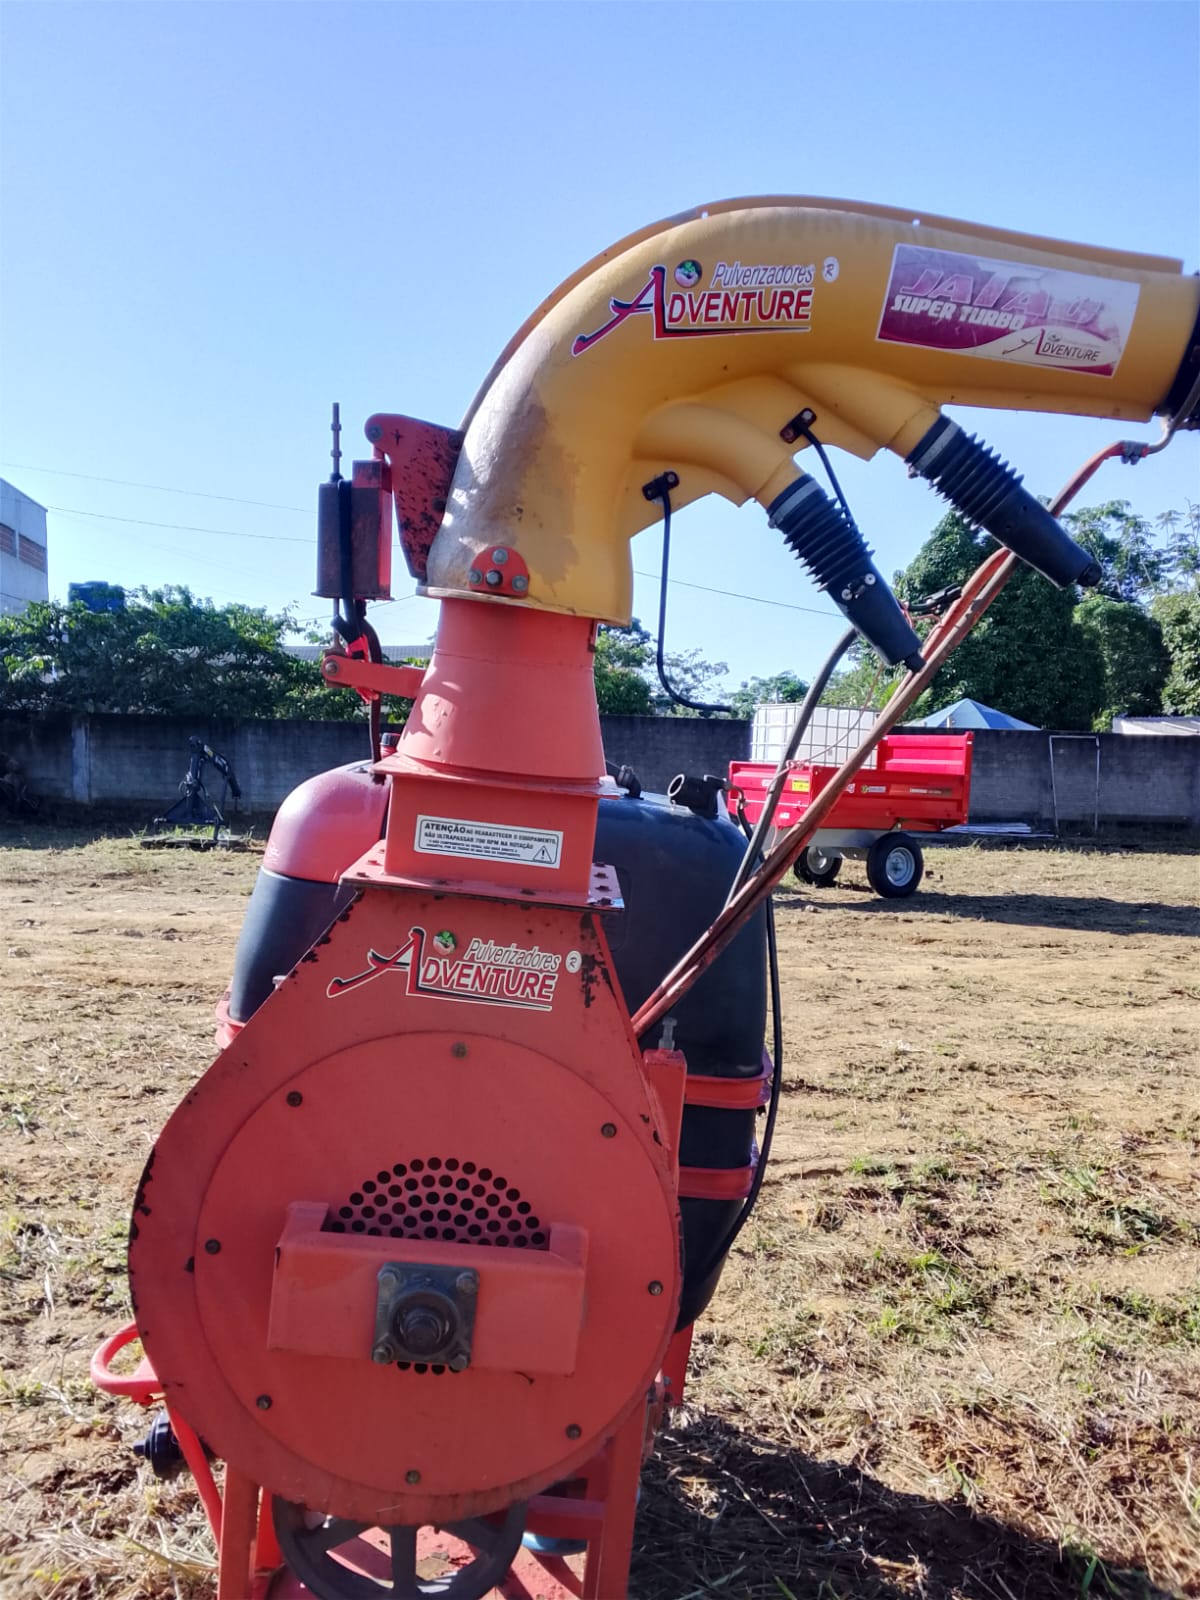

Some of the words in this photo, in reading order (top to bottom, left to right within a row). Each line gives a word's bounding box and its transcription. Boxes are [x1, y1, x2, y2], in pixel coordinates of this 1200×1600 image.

[710, 262, 814, 288] Pulverizadores
[572, 266, 813, 356] ADVENTURE
[891, 295, 957, 321] SUPER
[958, 306, 1027, 331] TURBO
[1002, 328, 1101, 362] ADVENTURE
[424, 822, 466, 834] ATENÇÃO
[327, 926, 558, 1002] ADVENTURE
[465, 938, 562, 972] Pulverizadores
